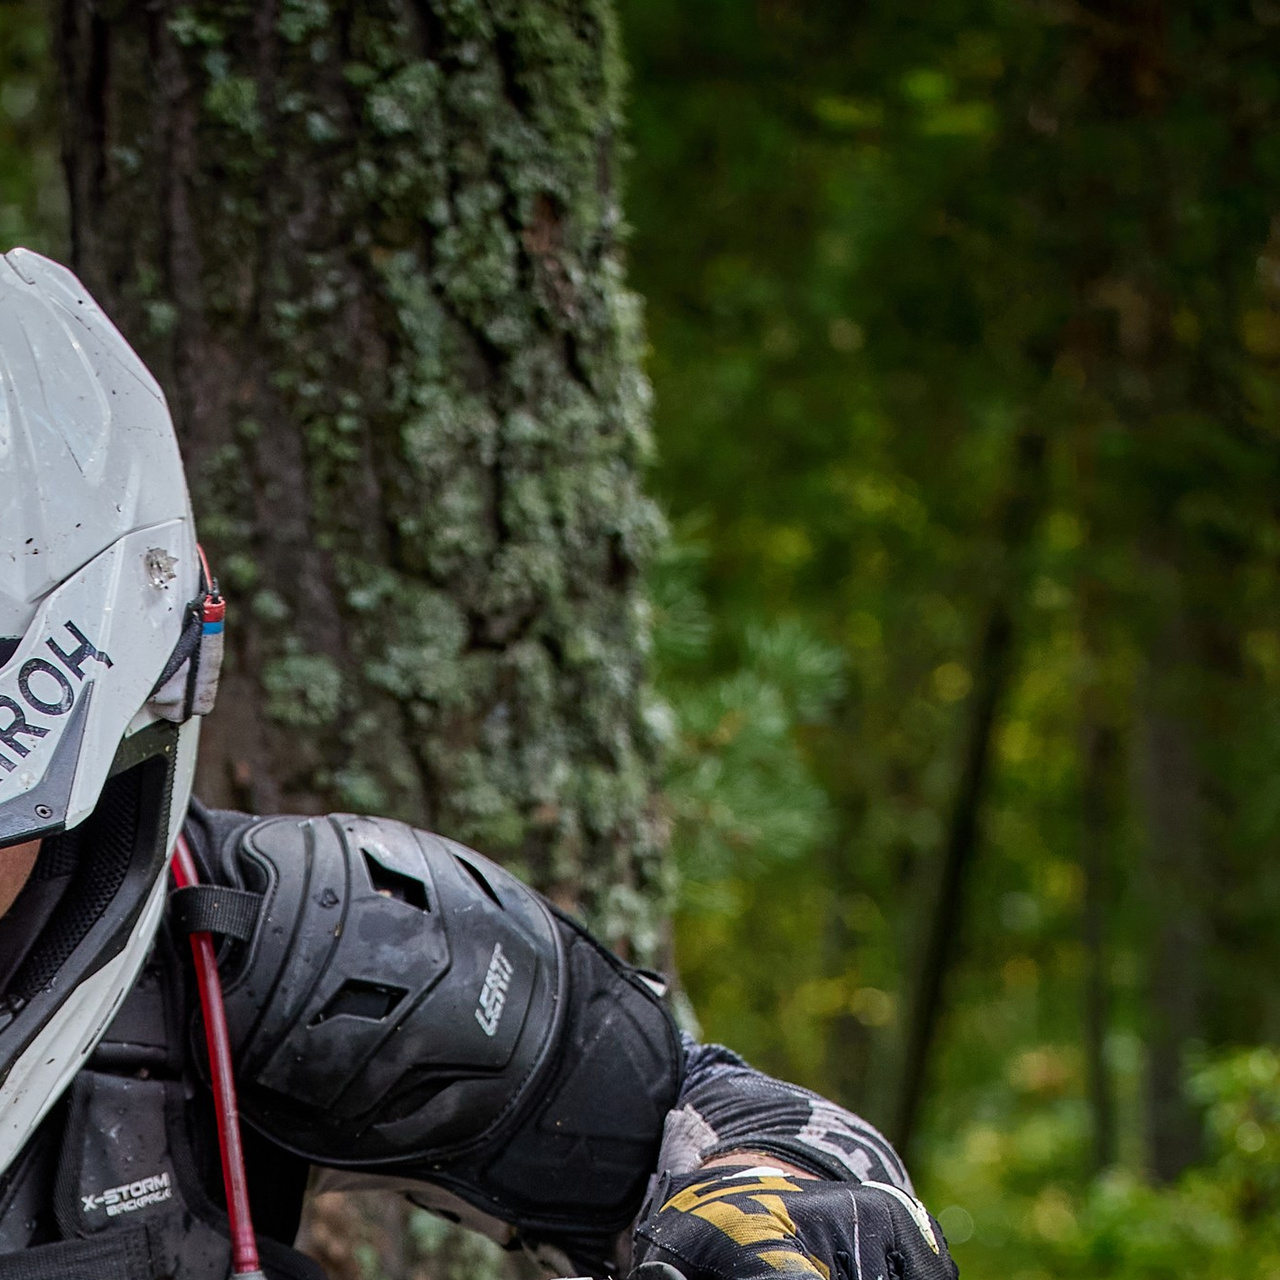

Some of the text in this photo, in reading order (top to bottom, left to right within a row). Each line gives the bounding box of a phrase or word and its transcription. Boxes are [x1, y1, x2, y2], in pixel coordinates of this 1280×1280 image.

[474, 942, 514, 1036] LEATT
[80, 1171, 171, 1213] X-STORM
[106, 1187, 173, 1217] BACKPACK
